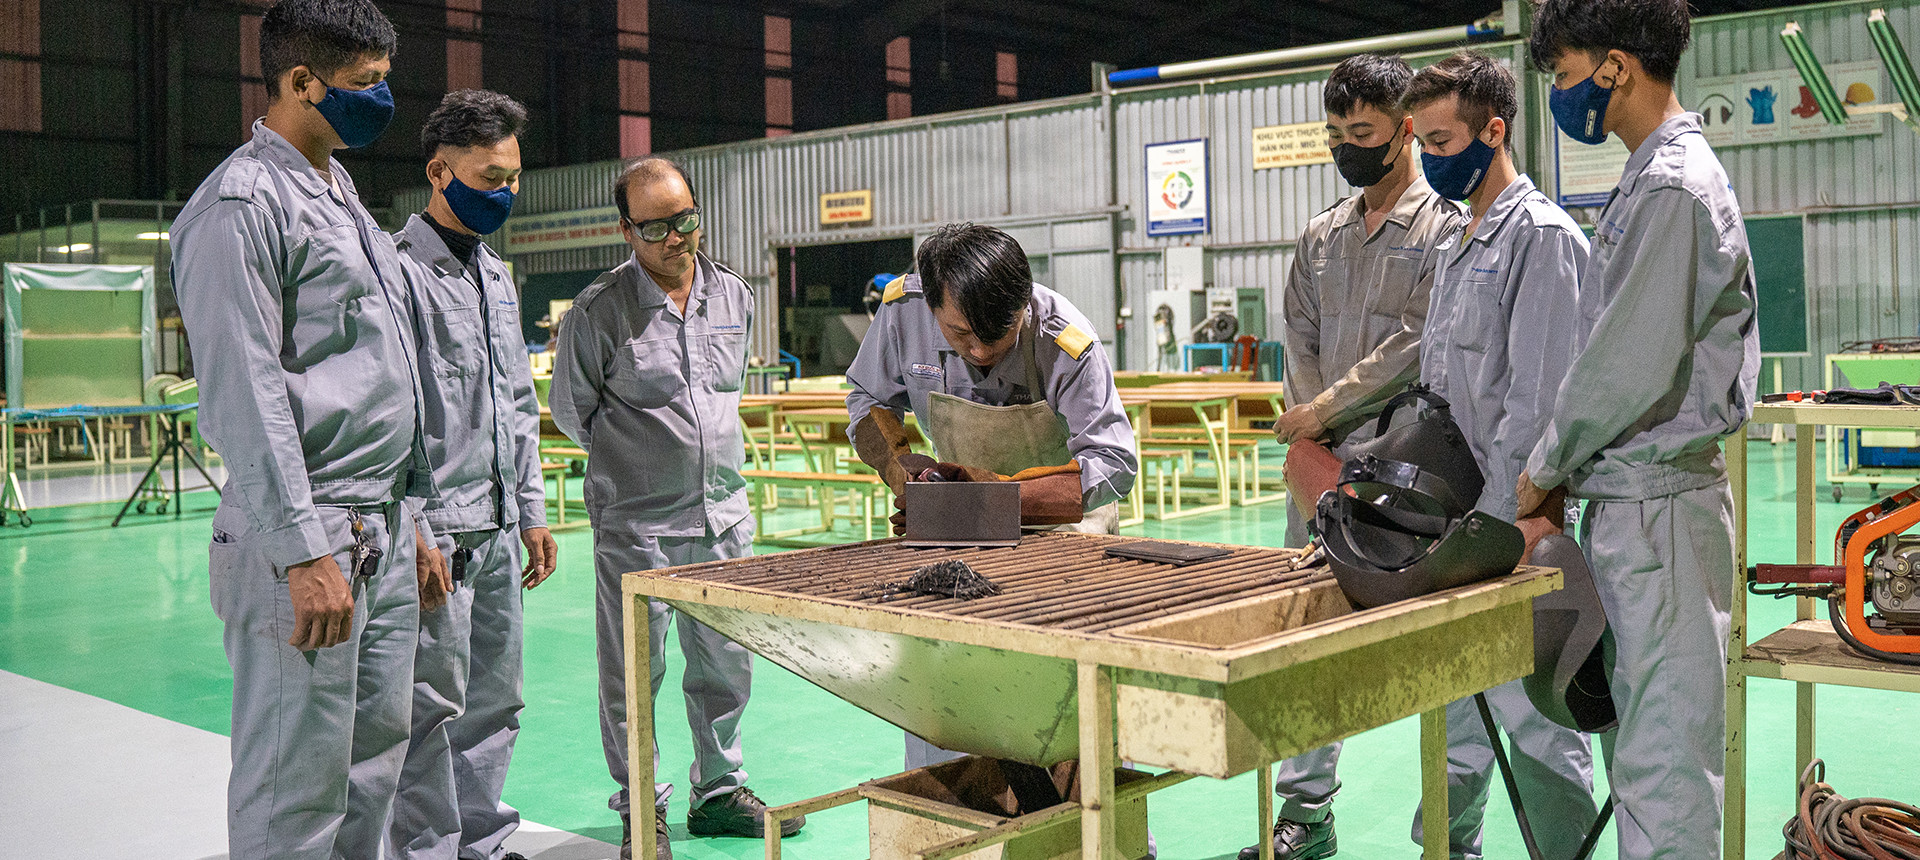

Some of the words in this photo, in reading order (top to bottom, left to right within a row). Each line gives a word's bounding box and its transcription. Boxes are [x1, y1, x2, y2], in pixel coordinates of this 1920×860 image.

[1256, 133, 1274, 141] KHU
[1300, 140, 1316, 149] MIG
[1295, 151, 1327, 160] WELDING
